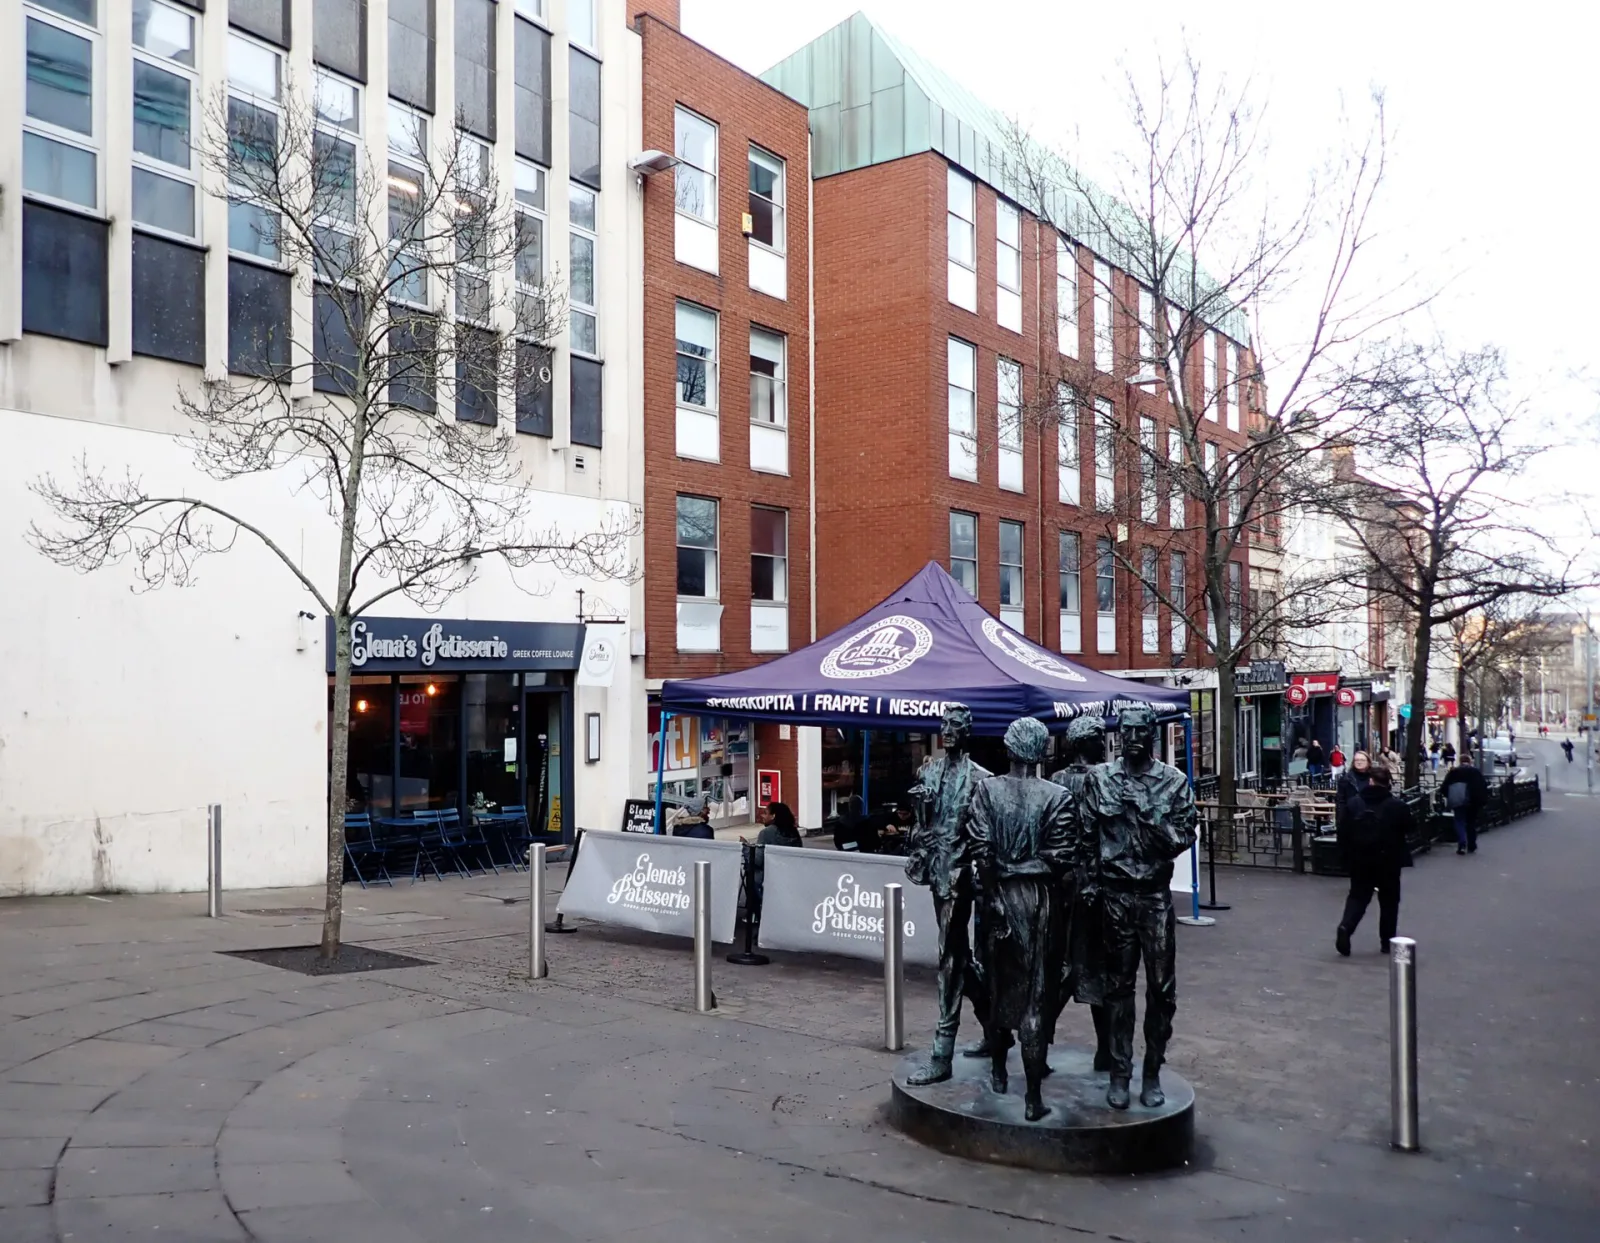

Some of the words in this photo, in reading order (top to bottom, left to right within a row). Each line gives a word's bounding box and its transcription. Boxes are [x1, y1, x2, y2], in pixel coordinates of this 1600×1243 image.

[351, 621, 417, 666] Elena's
[421, 623, 508, 666] Patisserie
[512, 650, 531, 658] GREEK
[531, 650, 552, 658] COFFEE
[552, 650, 574, 658] LOUNGE
[840, 645, 909, 660] GREEK
[706, 694, 795, 711] SPANAKOPITA
[814, 693, 868, 713] FRAPPE
[889, 698, 956, 717] NESCAF
[1053, 701, 1074, 718] PITA
[632, 853, 686, 887] Elena's
[606, 873, 691, 909] Patisserie
[835, 873, 905, 912] Elen
[812, 896, 916, 937] Patissee
